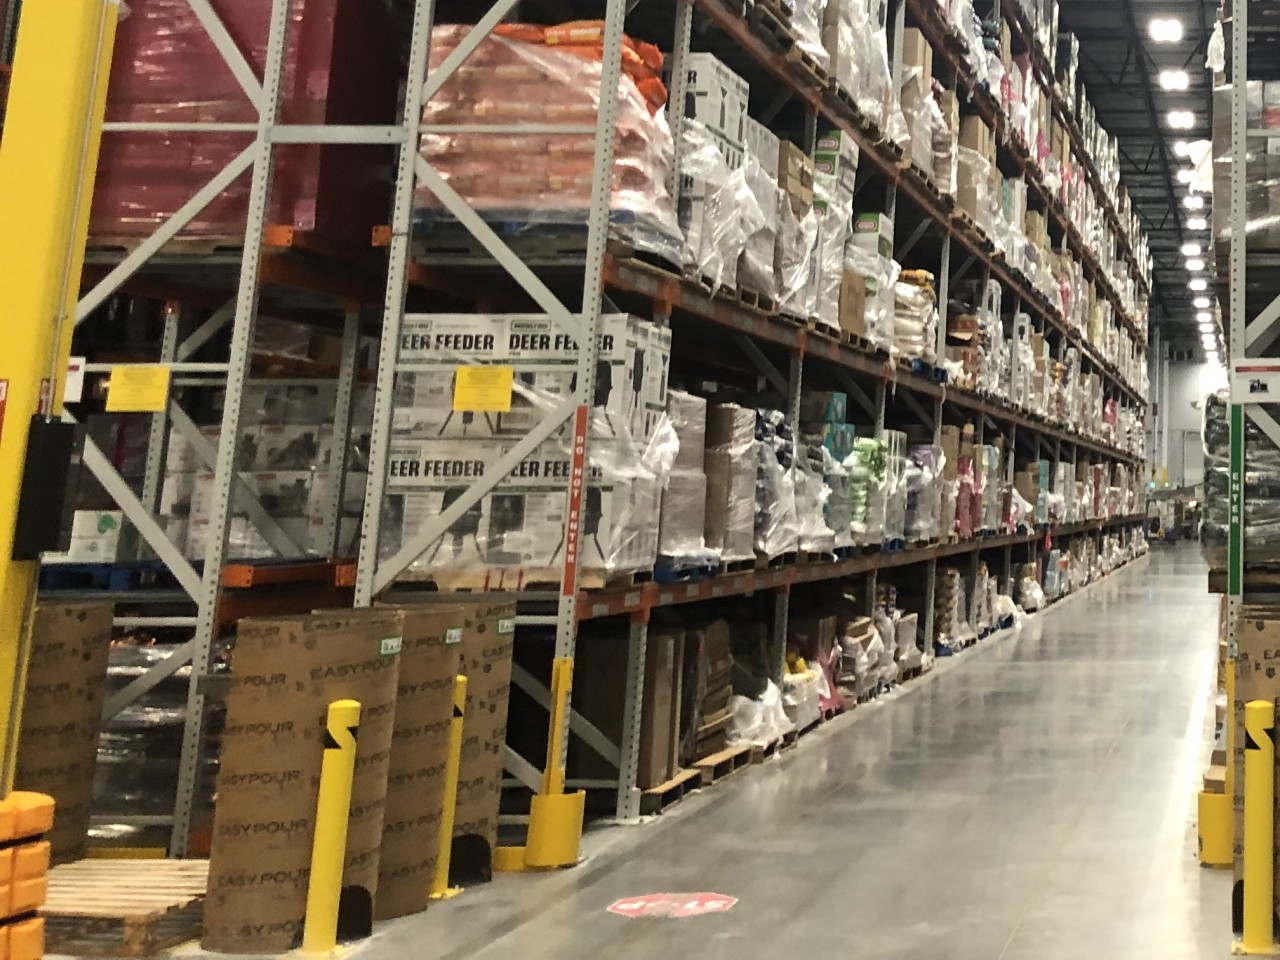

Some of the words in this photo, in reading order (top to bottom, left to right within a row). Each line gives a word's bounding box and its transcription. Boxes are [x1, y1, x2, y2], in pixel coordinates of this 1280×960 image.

[402, 334, 431, 351] EER
[435, 334, 495, 352] FEEDER
[509, 333, 551, 351] DEER
[576, 435, 585, 455] DO
[390, 460, 420, 477] EER
[424, 460, 485, 477] FEEDER
[573, 468, 583, 497] NOT
[1231, 472, 1239, 524] ENTER
[567, 510, 578, 563] ENTER
[310, 665, 359, 680] EASY
[250, 770, 300, 785] POUR
[254, 818, 308, 834] POUR
[218, 874, 257, 887] EASY
